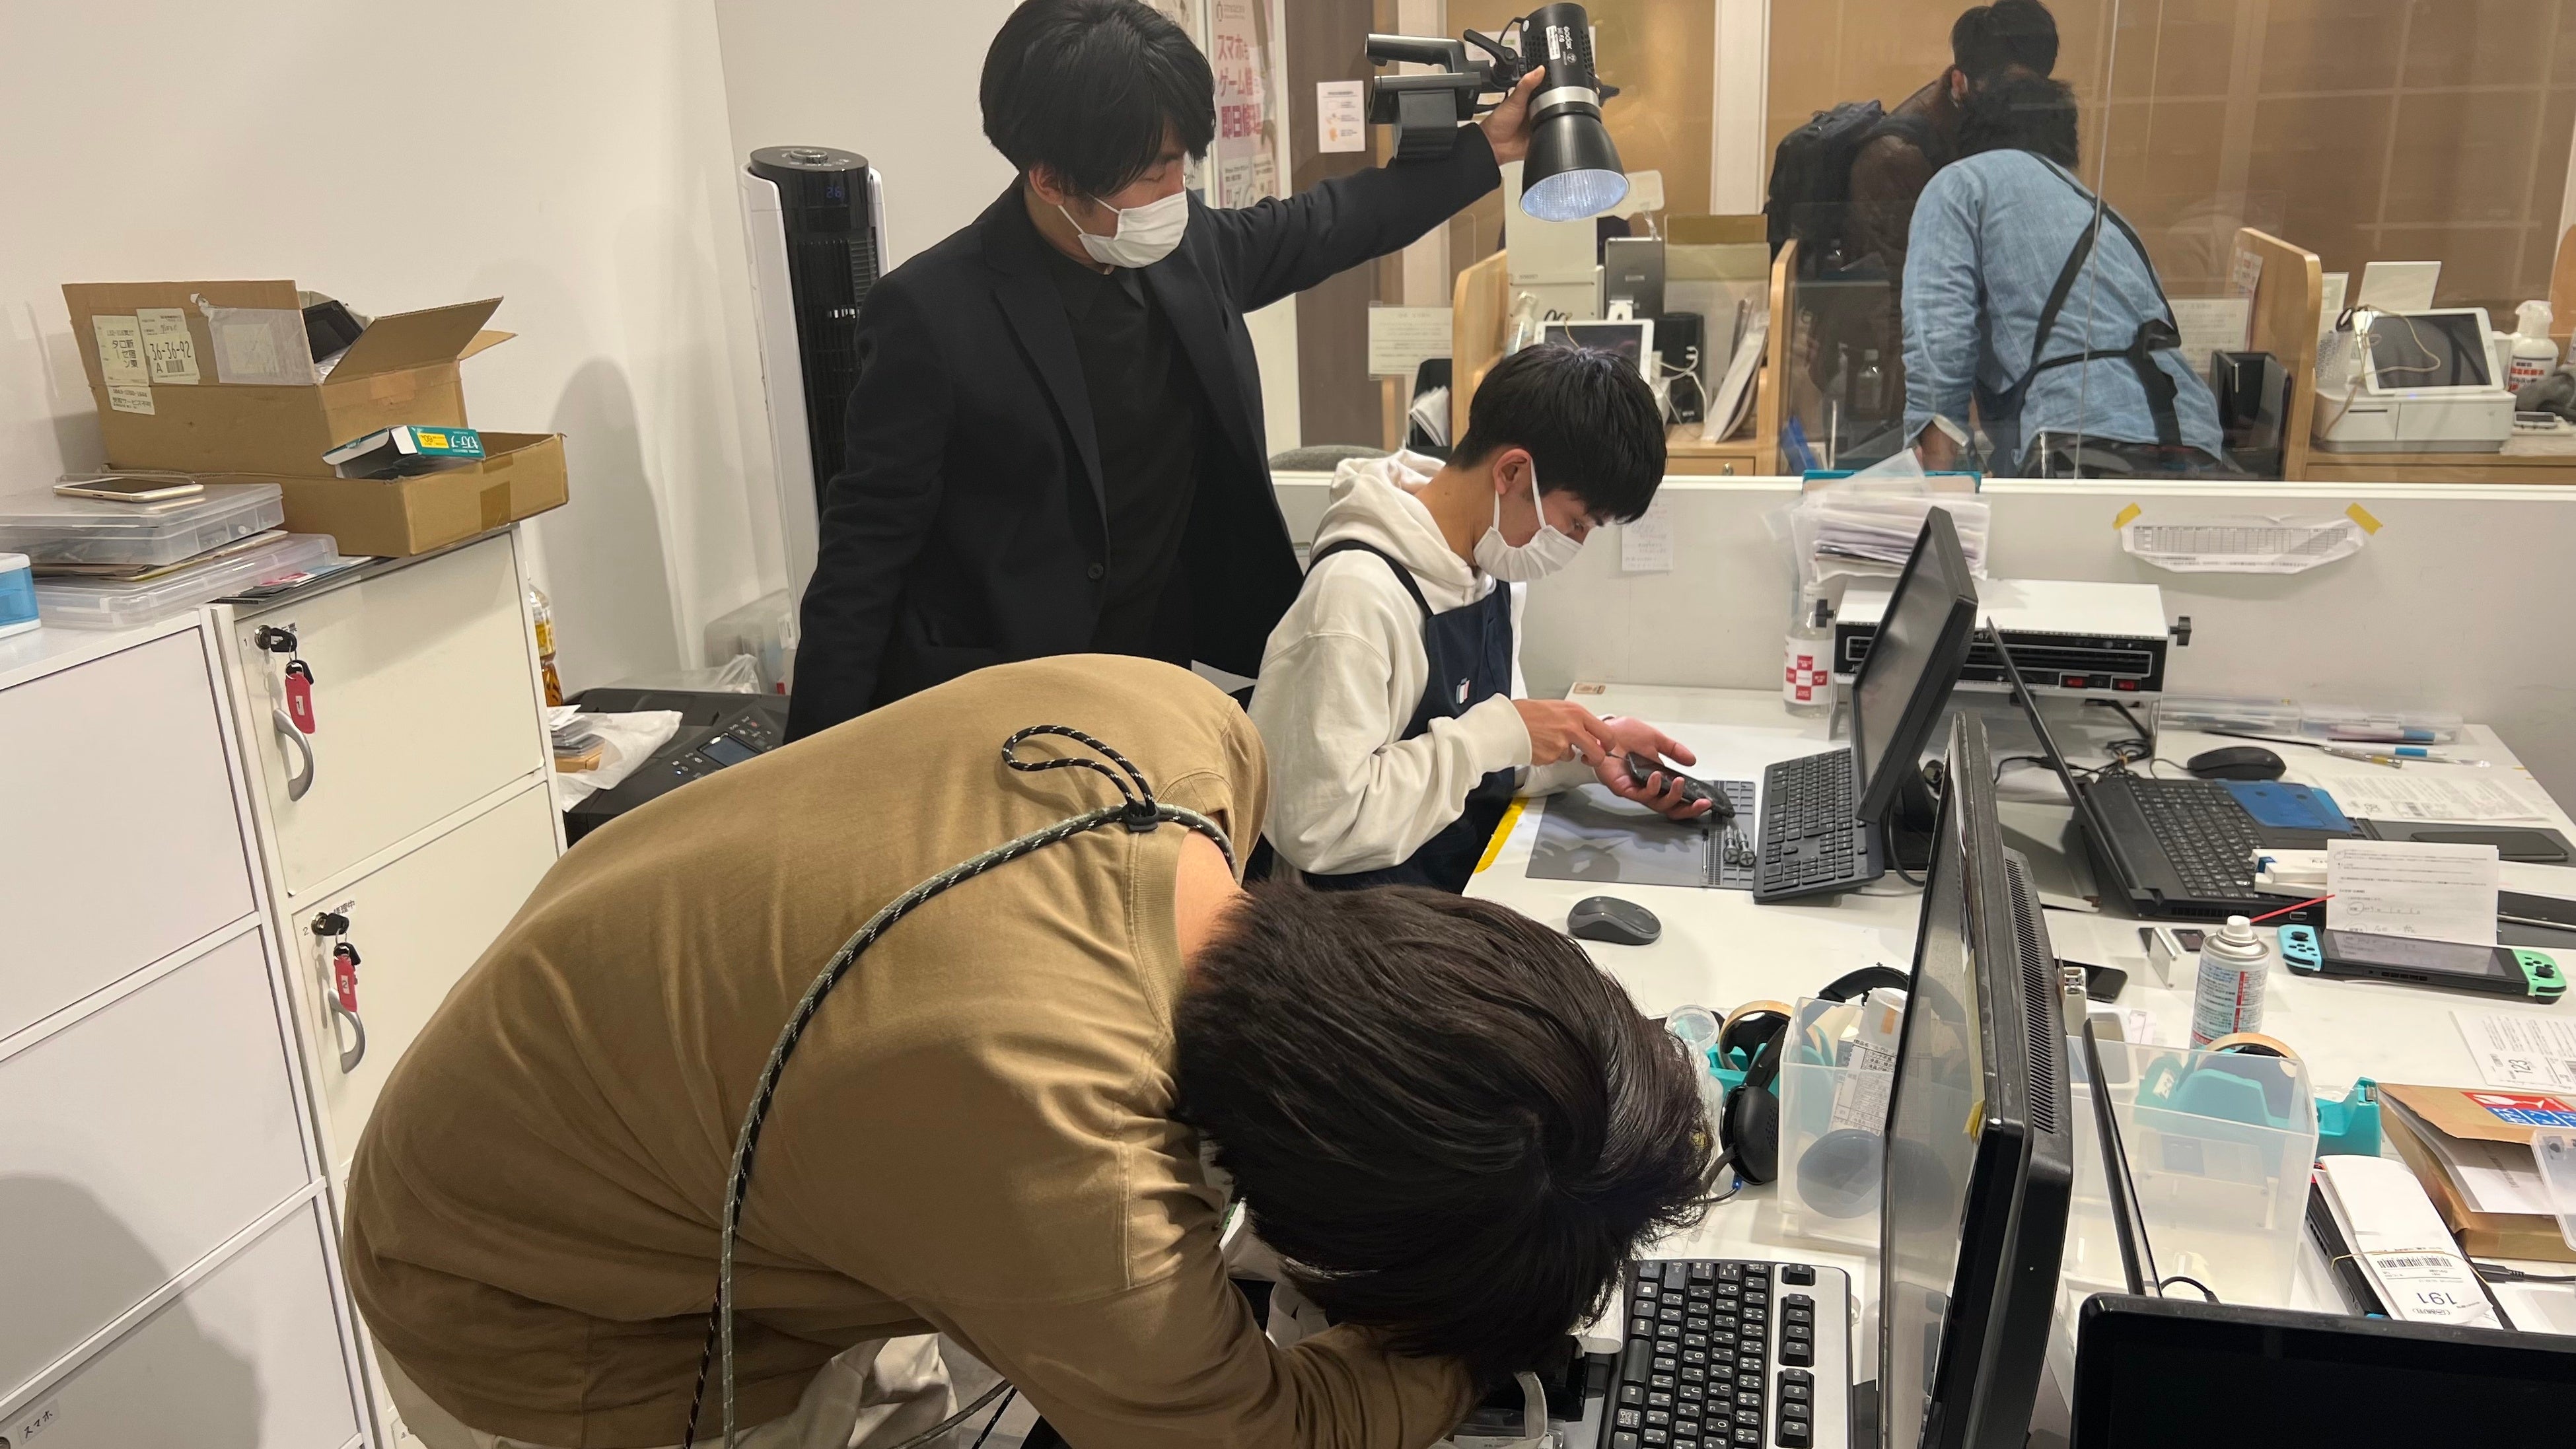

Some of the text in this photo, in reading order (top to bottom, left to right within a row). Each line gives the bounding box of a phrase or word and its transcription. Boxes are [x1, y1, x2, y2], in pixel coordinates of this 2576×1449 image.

[828, 186, 842, 197] 26
[149, 341, 192, 361] 36-36-92
[157, 363, 163, 373] A
[303, 927, 309, 935] 2
[2508, 1059, 2533, 1074] 123
[2416, 1292, 2457, 1305] 191
[23, 1409, 54, 1439] スマホ
